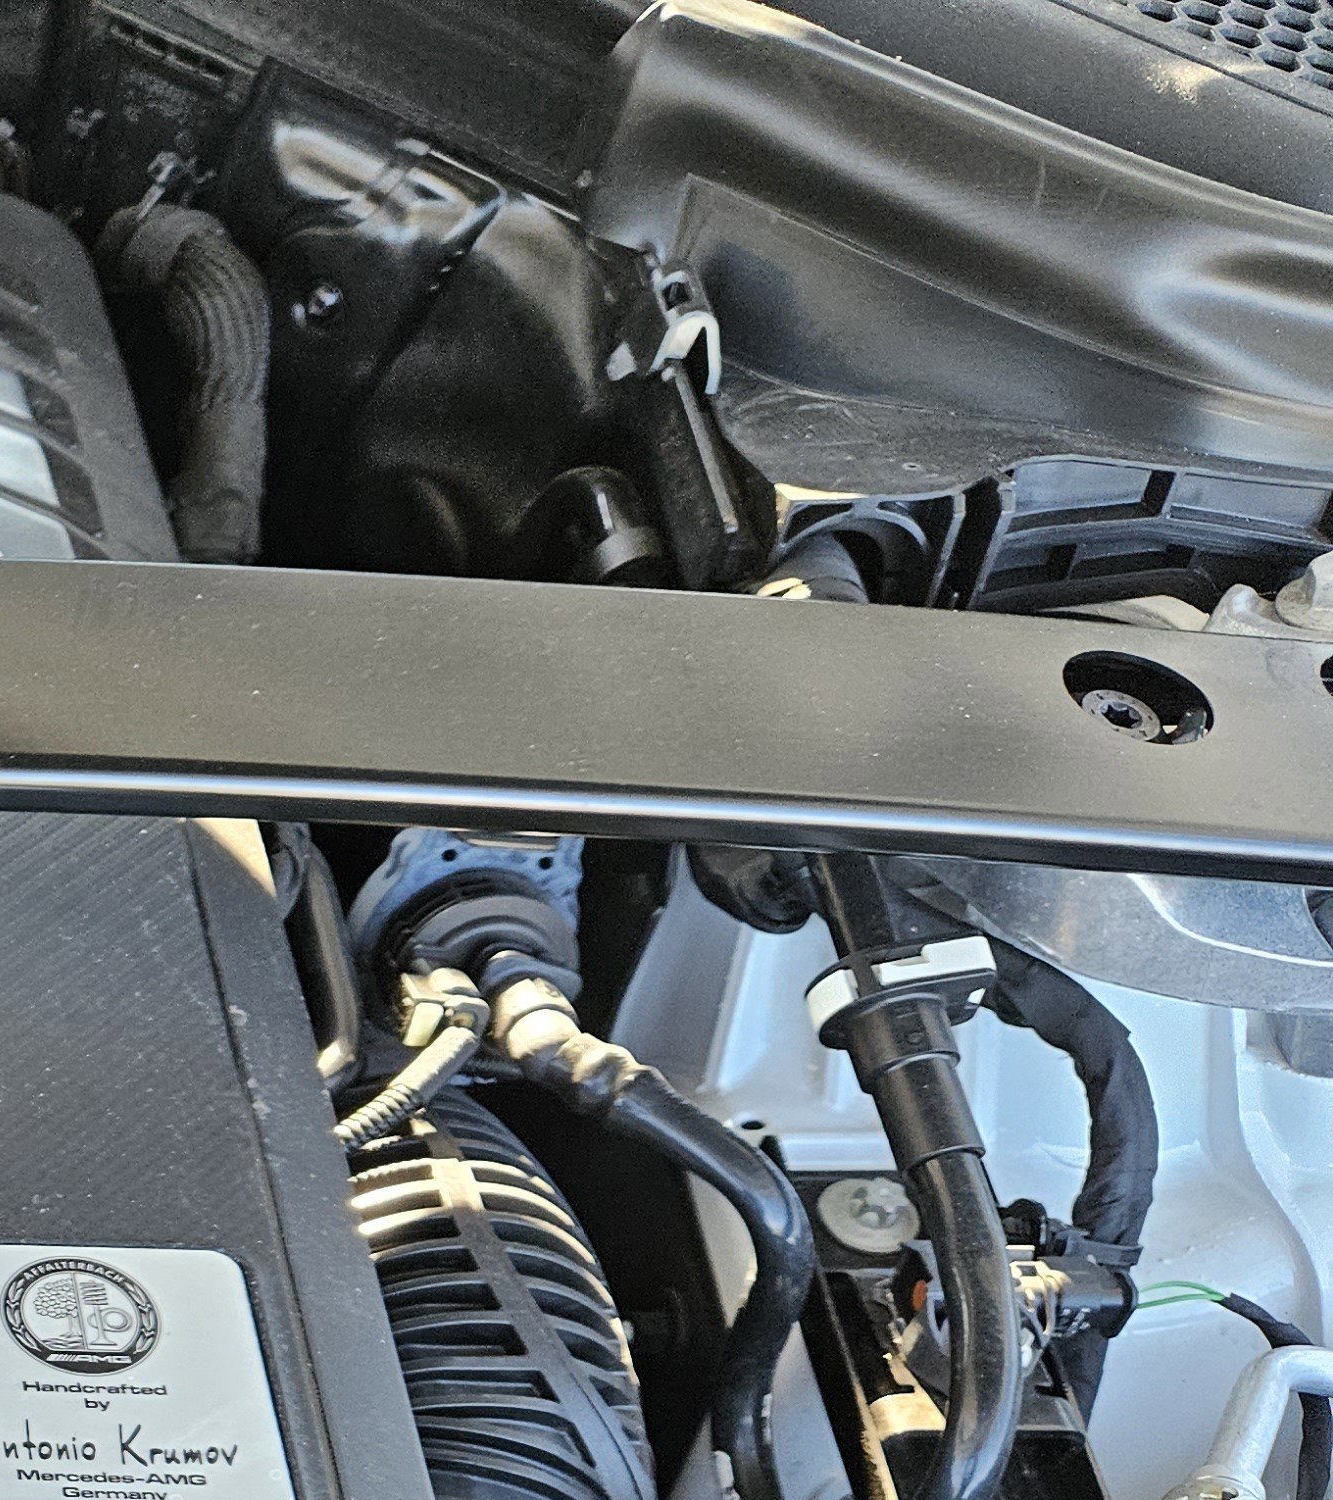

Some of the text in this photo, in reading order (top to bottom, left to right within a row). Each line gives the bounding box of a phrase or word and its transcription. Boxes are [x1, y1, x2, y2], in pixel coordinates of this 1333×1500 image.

[23, 1261, 124, 1283] AFFALTERBACH
[75, 1354, 132, 1364] AMG
[22, 1381, 167, 1396] Handcrafted
[84, 1397, 110, 1412] by
[118, 1422, 239, 1467] Krumov
[16, 1469, 207, 1486] Mercedes-AMG
